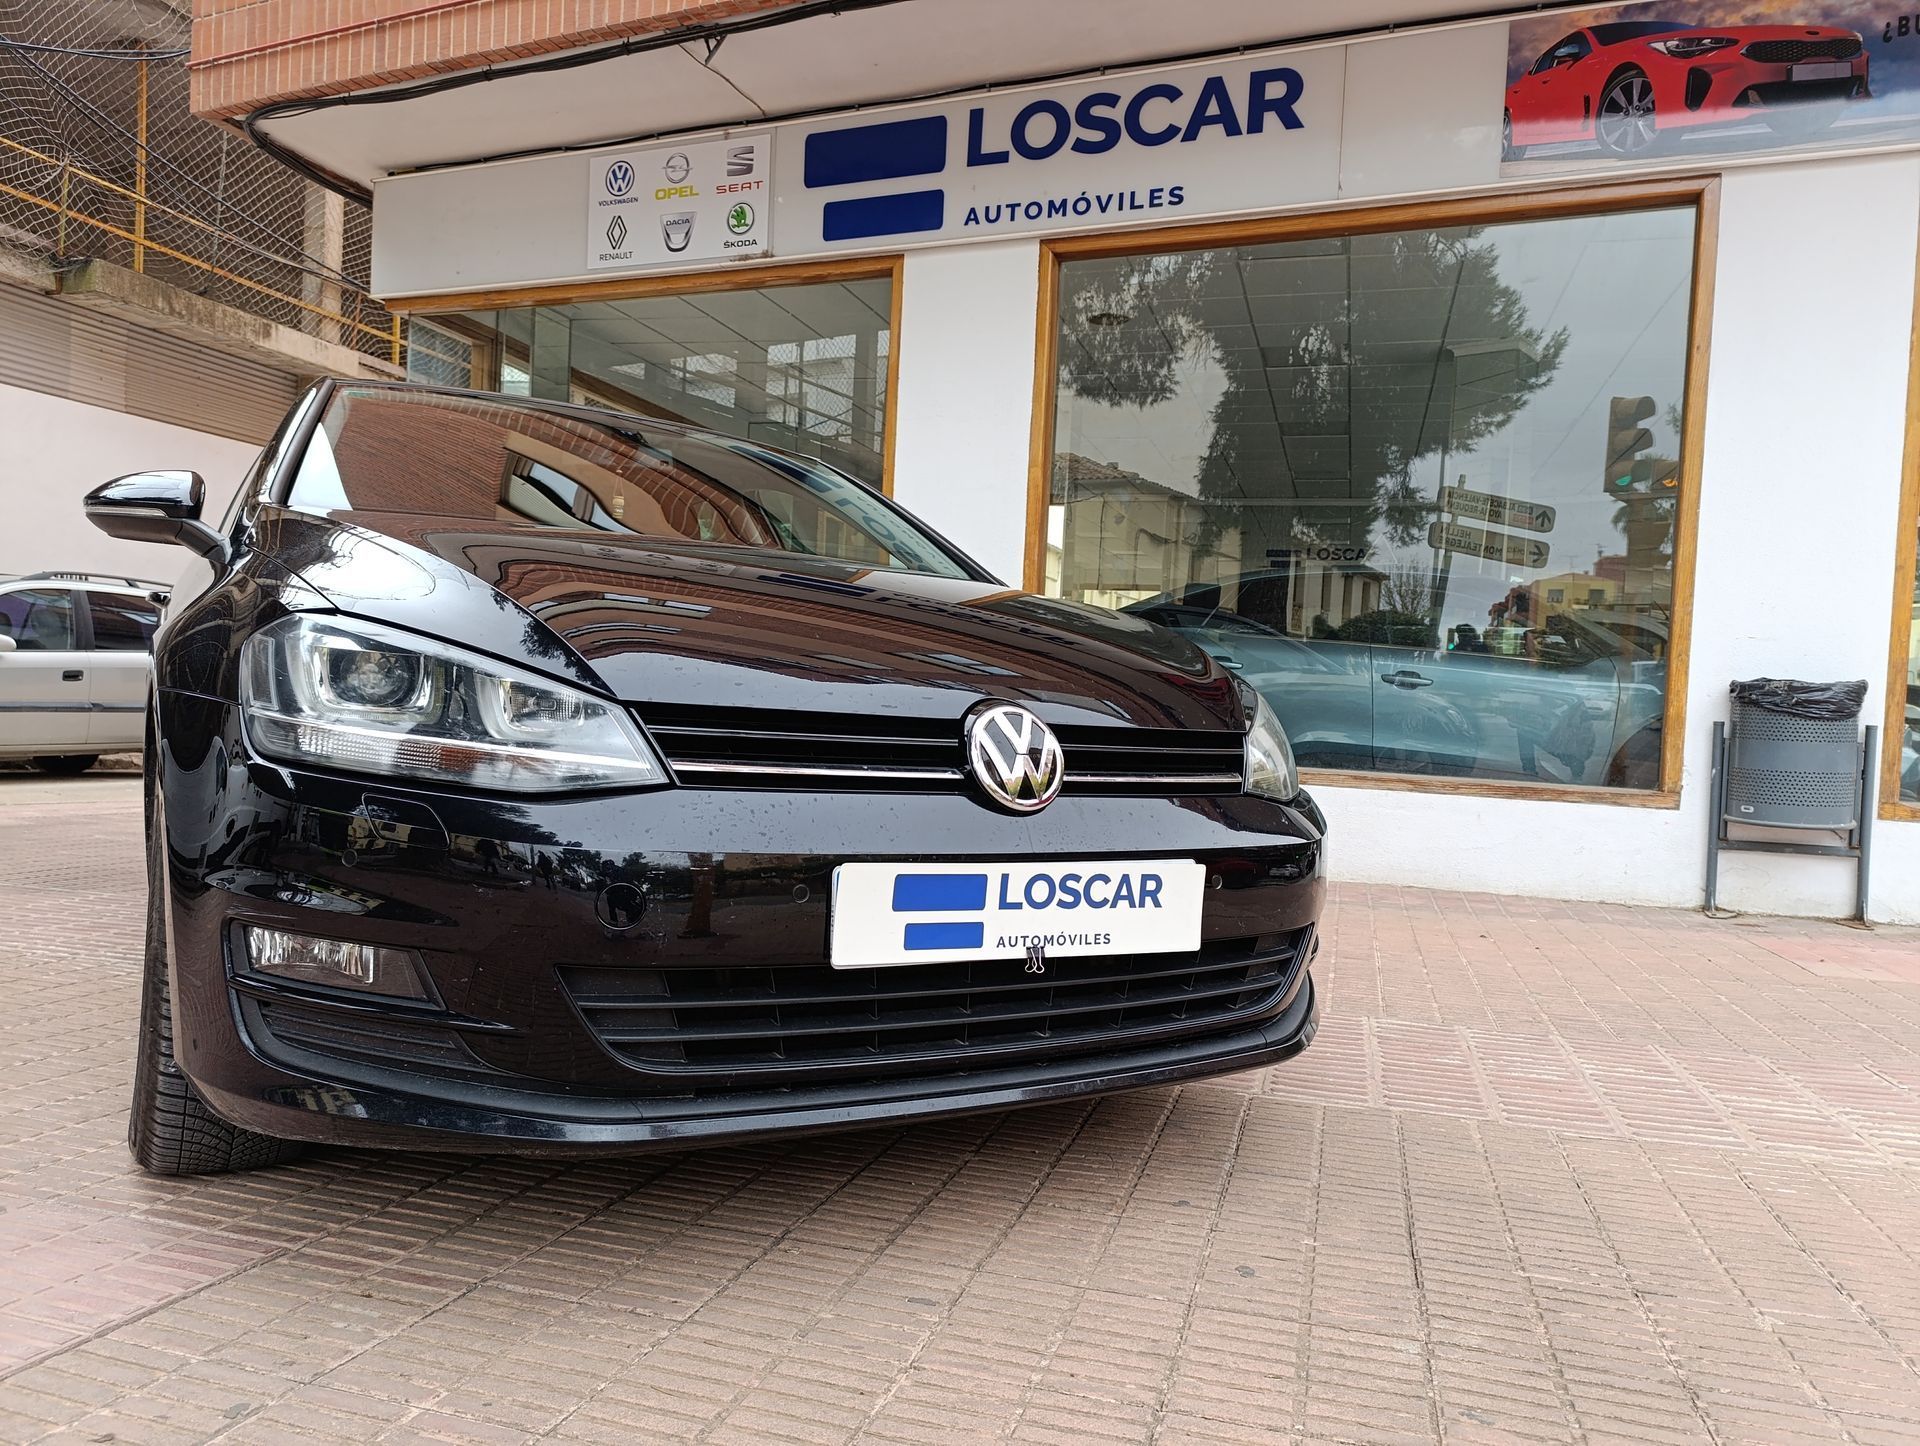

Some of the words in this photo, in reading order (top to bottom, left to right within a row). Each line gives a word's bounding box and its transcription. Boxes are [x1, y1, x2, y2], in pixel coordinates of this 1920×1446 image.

[966, 67, 1305, 168] LOSCAR
[655, 185, 699, 201] OPEL
[716, 180, 764, 195] SEAT
[598, 197, 639, 207] VOLKSWAGEN
[963, 185, 1185, 227] AUTOMÓVILES
[665, 218, 691, 227] DACIA
[723, 238, 758, 249] ŠKODA
[599, 251, 634, 262] RENAULT
[998, 873, 1163, 910] LOSCAR
[996, 931, 1111, 949] AUTOMÓVILES
